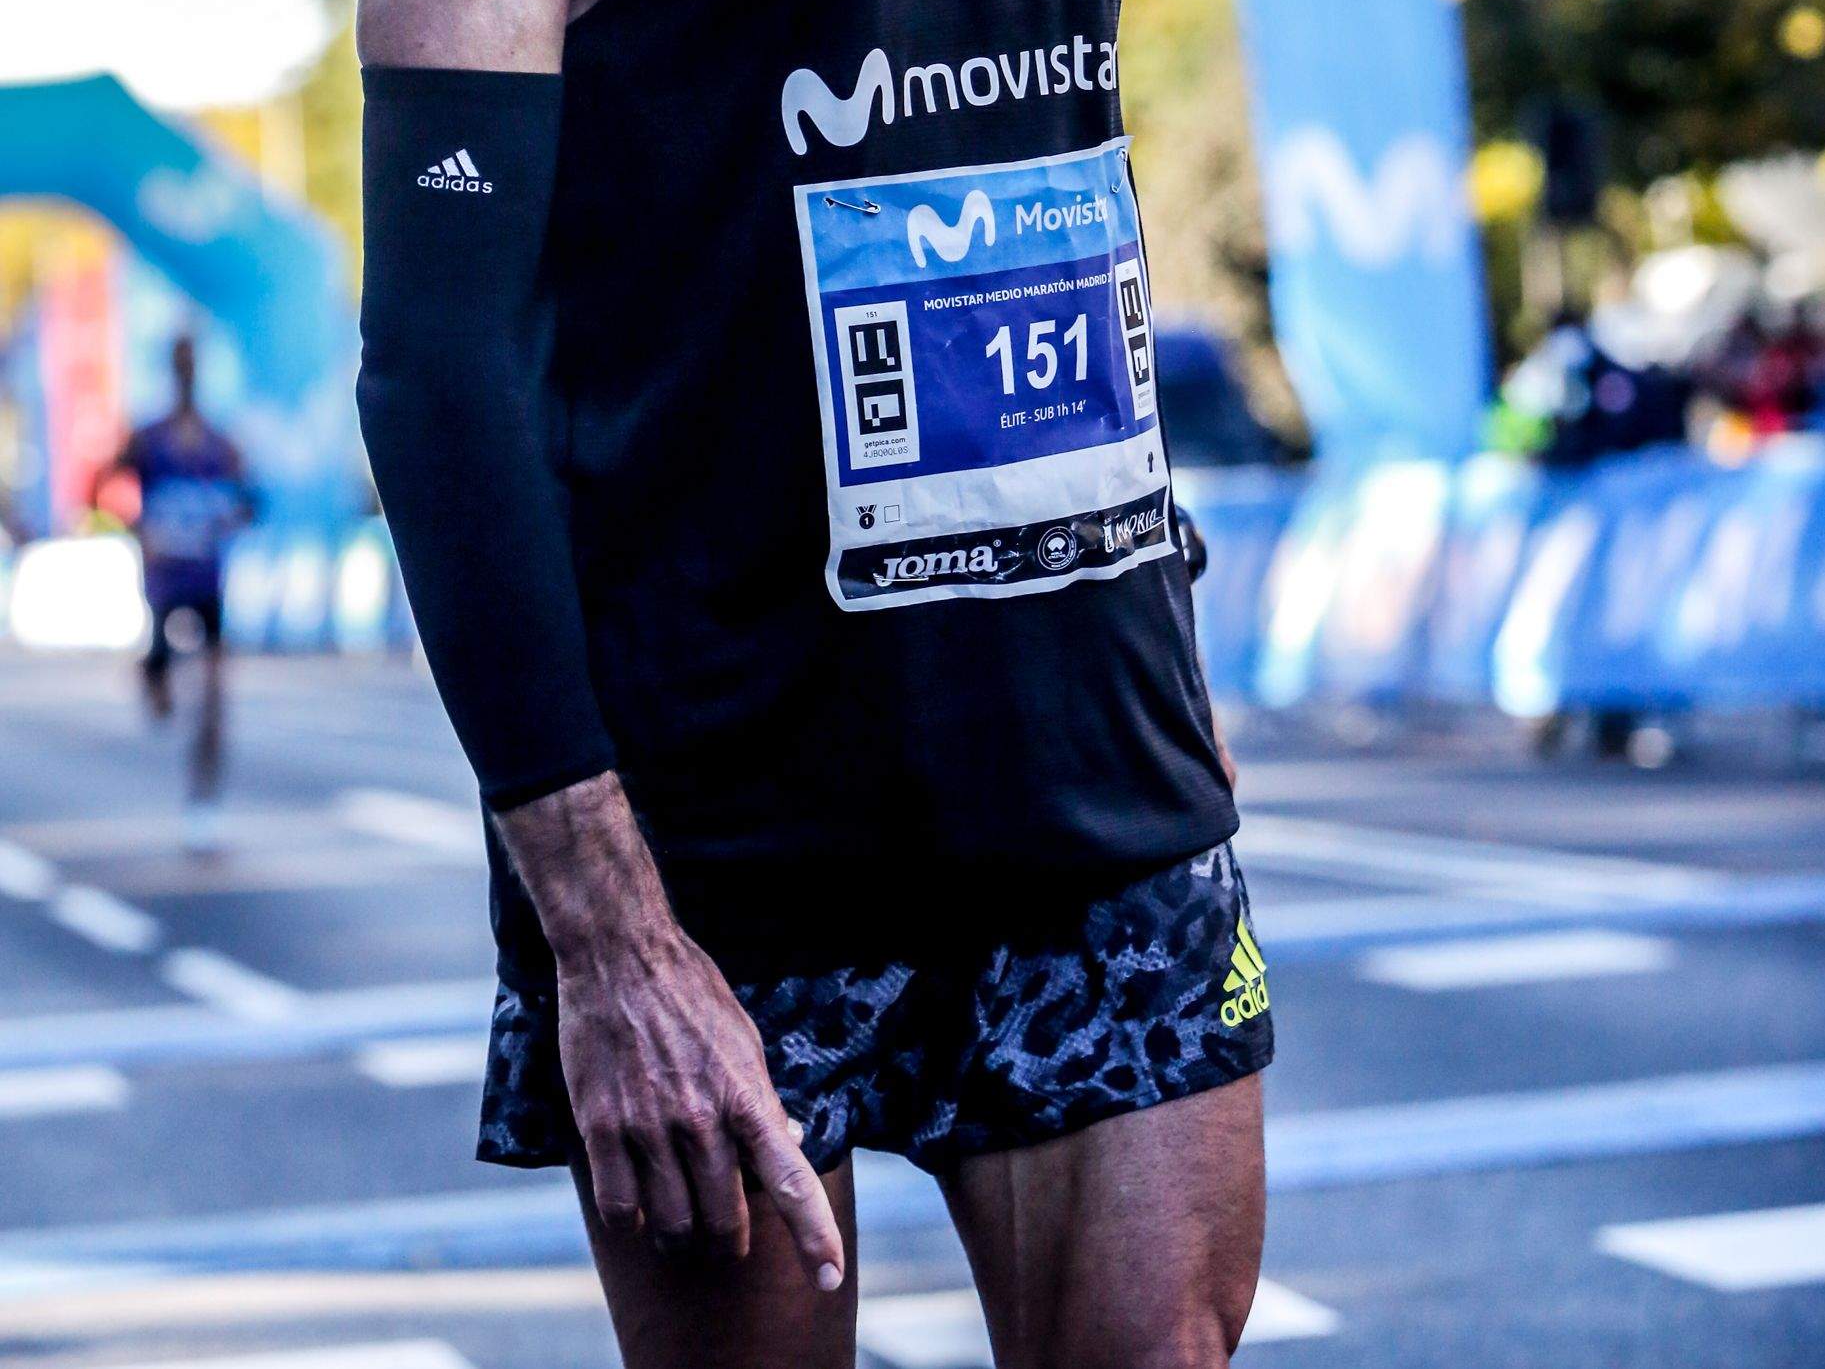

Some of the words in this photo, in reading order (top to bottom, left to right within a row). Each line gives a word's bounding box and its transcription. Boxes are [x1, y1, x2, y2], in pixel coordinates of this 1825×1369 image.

[416, 174, 493, 194] adidas
[1015, 193, 1108, 235] Movist
[924, 293, 984, 311] MOVISTAR
[985, 283, 1022, 304] MEDIO
[1023, 278, 1075, 298] MARATÓN
[1076, 273, 1108, 290] MADRID
[865, 311, 878, 319] 151
[985, 313, 1088, 395] 151
[1000, 411, 1027, 429] ÉLITE
[1034, 405, 1055, 422] SUB
[1056, 402, 1069, 417] 1h
[864, 437, 906, 449] getpica.com
[1220, 974, 1270, 1027] adid
